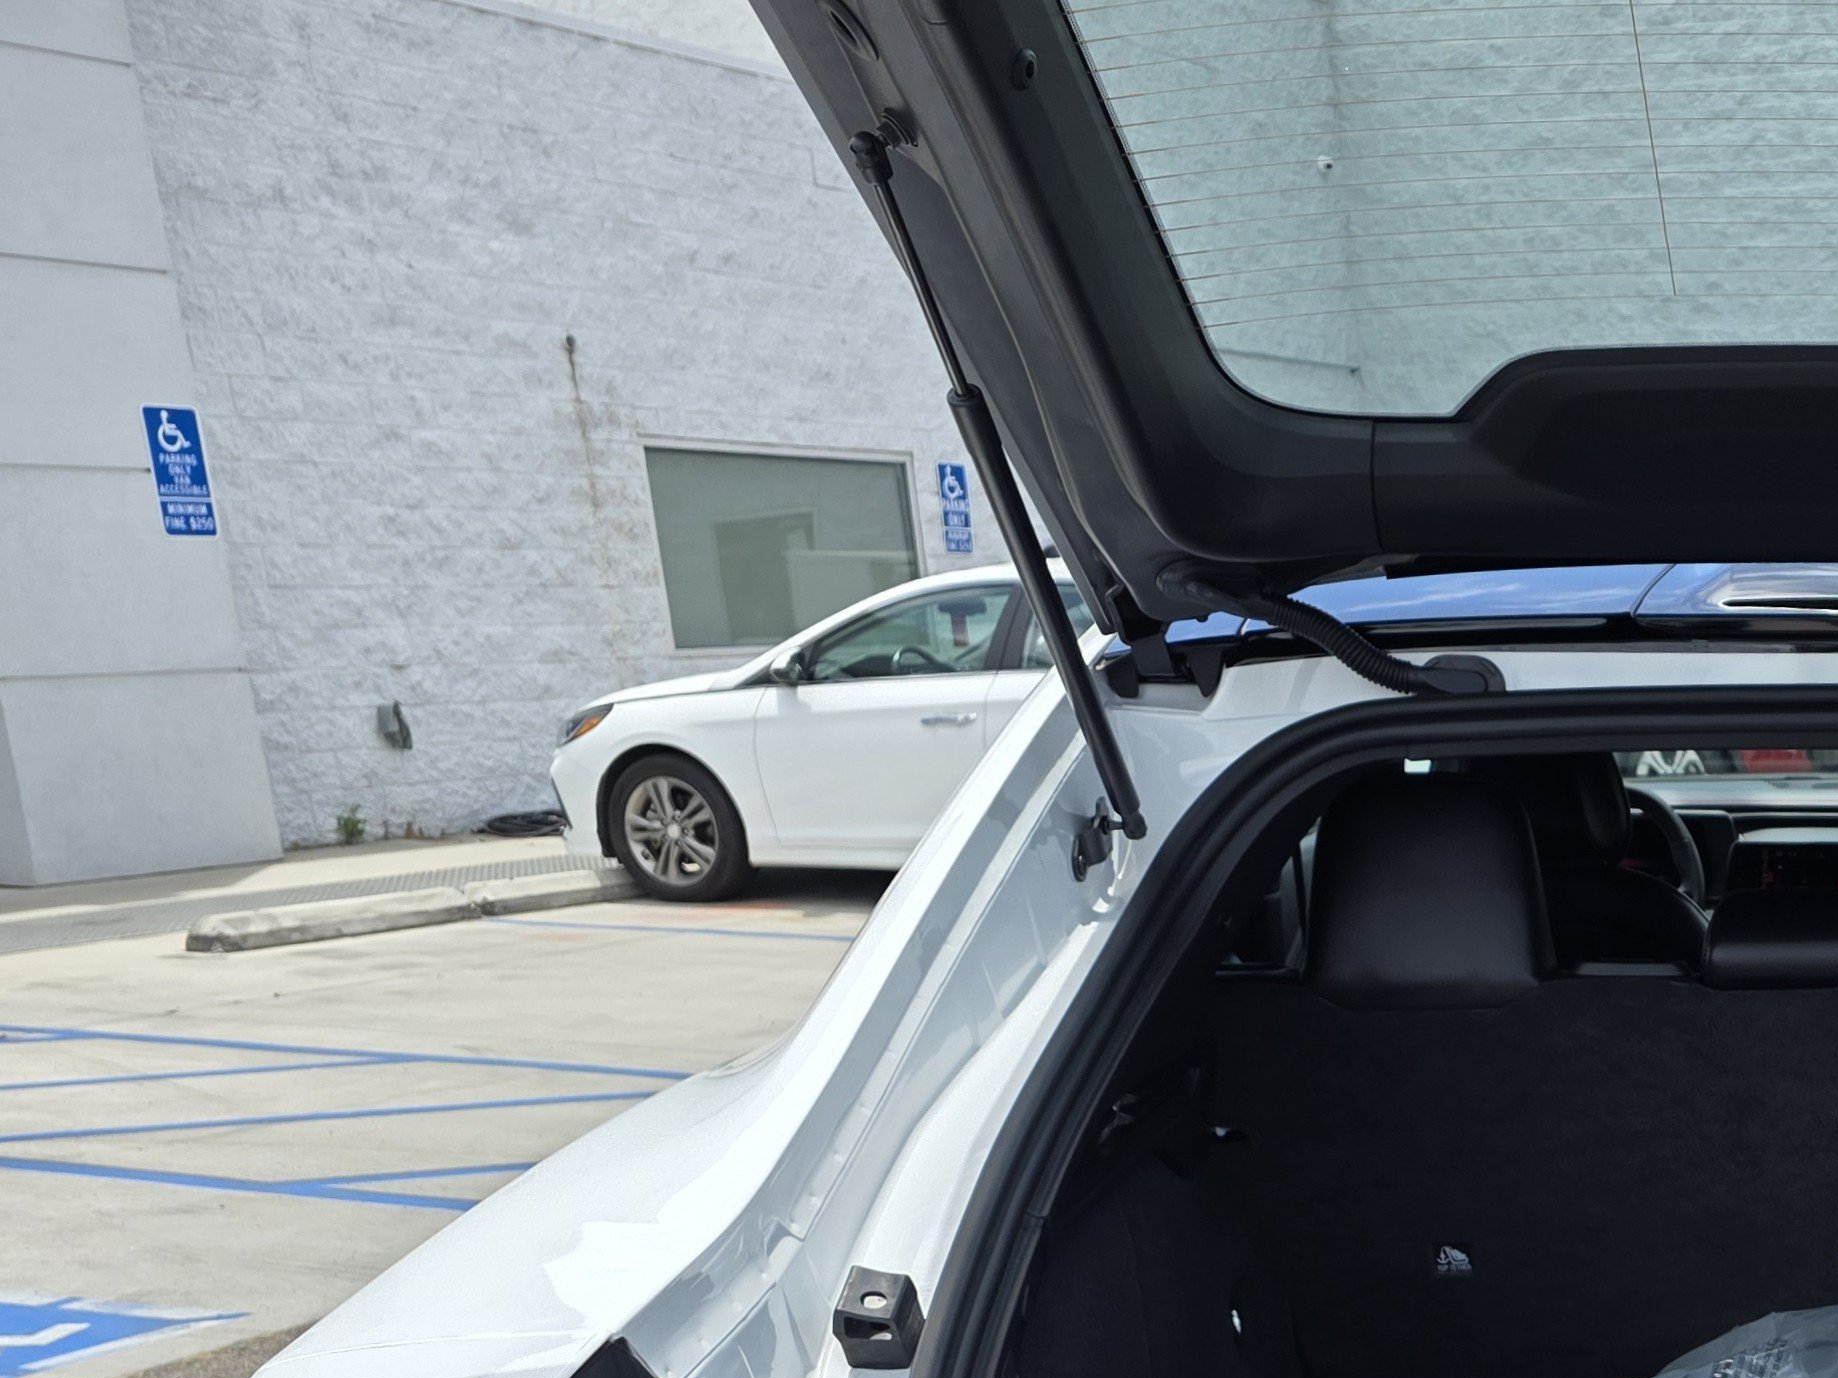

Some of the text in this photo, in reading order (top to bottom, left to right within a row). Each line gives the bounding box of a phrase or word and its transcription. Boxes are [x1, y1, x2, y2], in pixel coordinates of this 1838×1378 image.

[159, 452, 197, 467] PARKING
[168, 463, 192, 476] ONLY
[173, 474, 191, 485] VAN
[160, 484, 208, 496] ACCESSIBLE
[167, 503, 208, 515] MINIMUM
[165, 516, 214, 531] FINE $250
